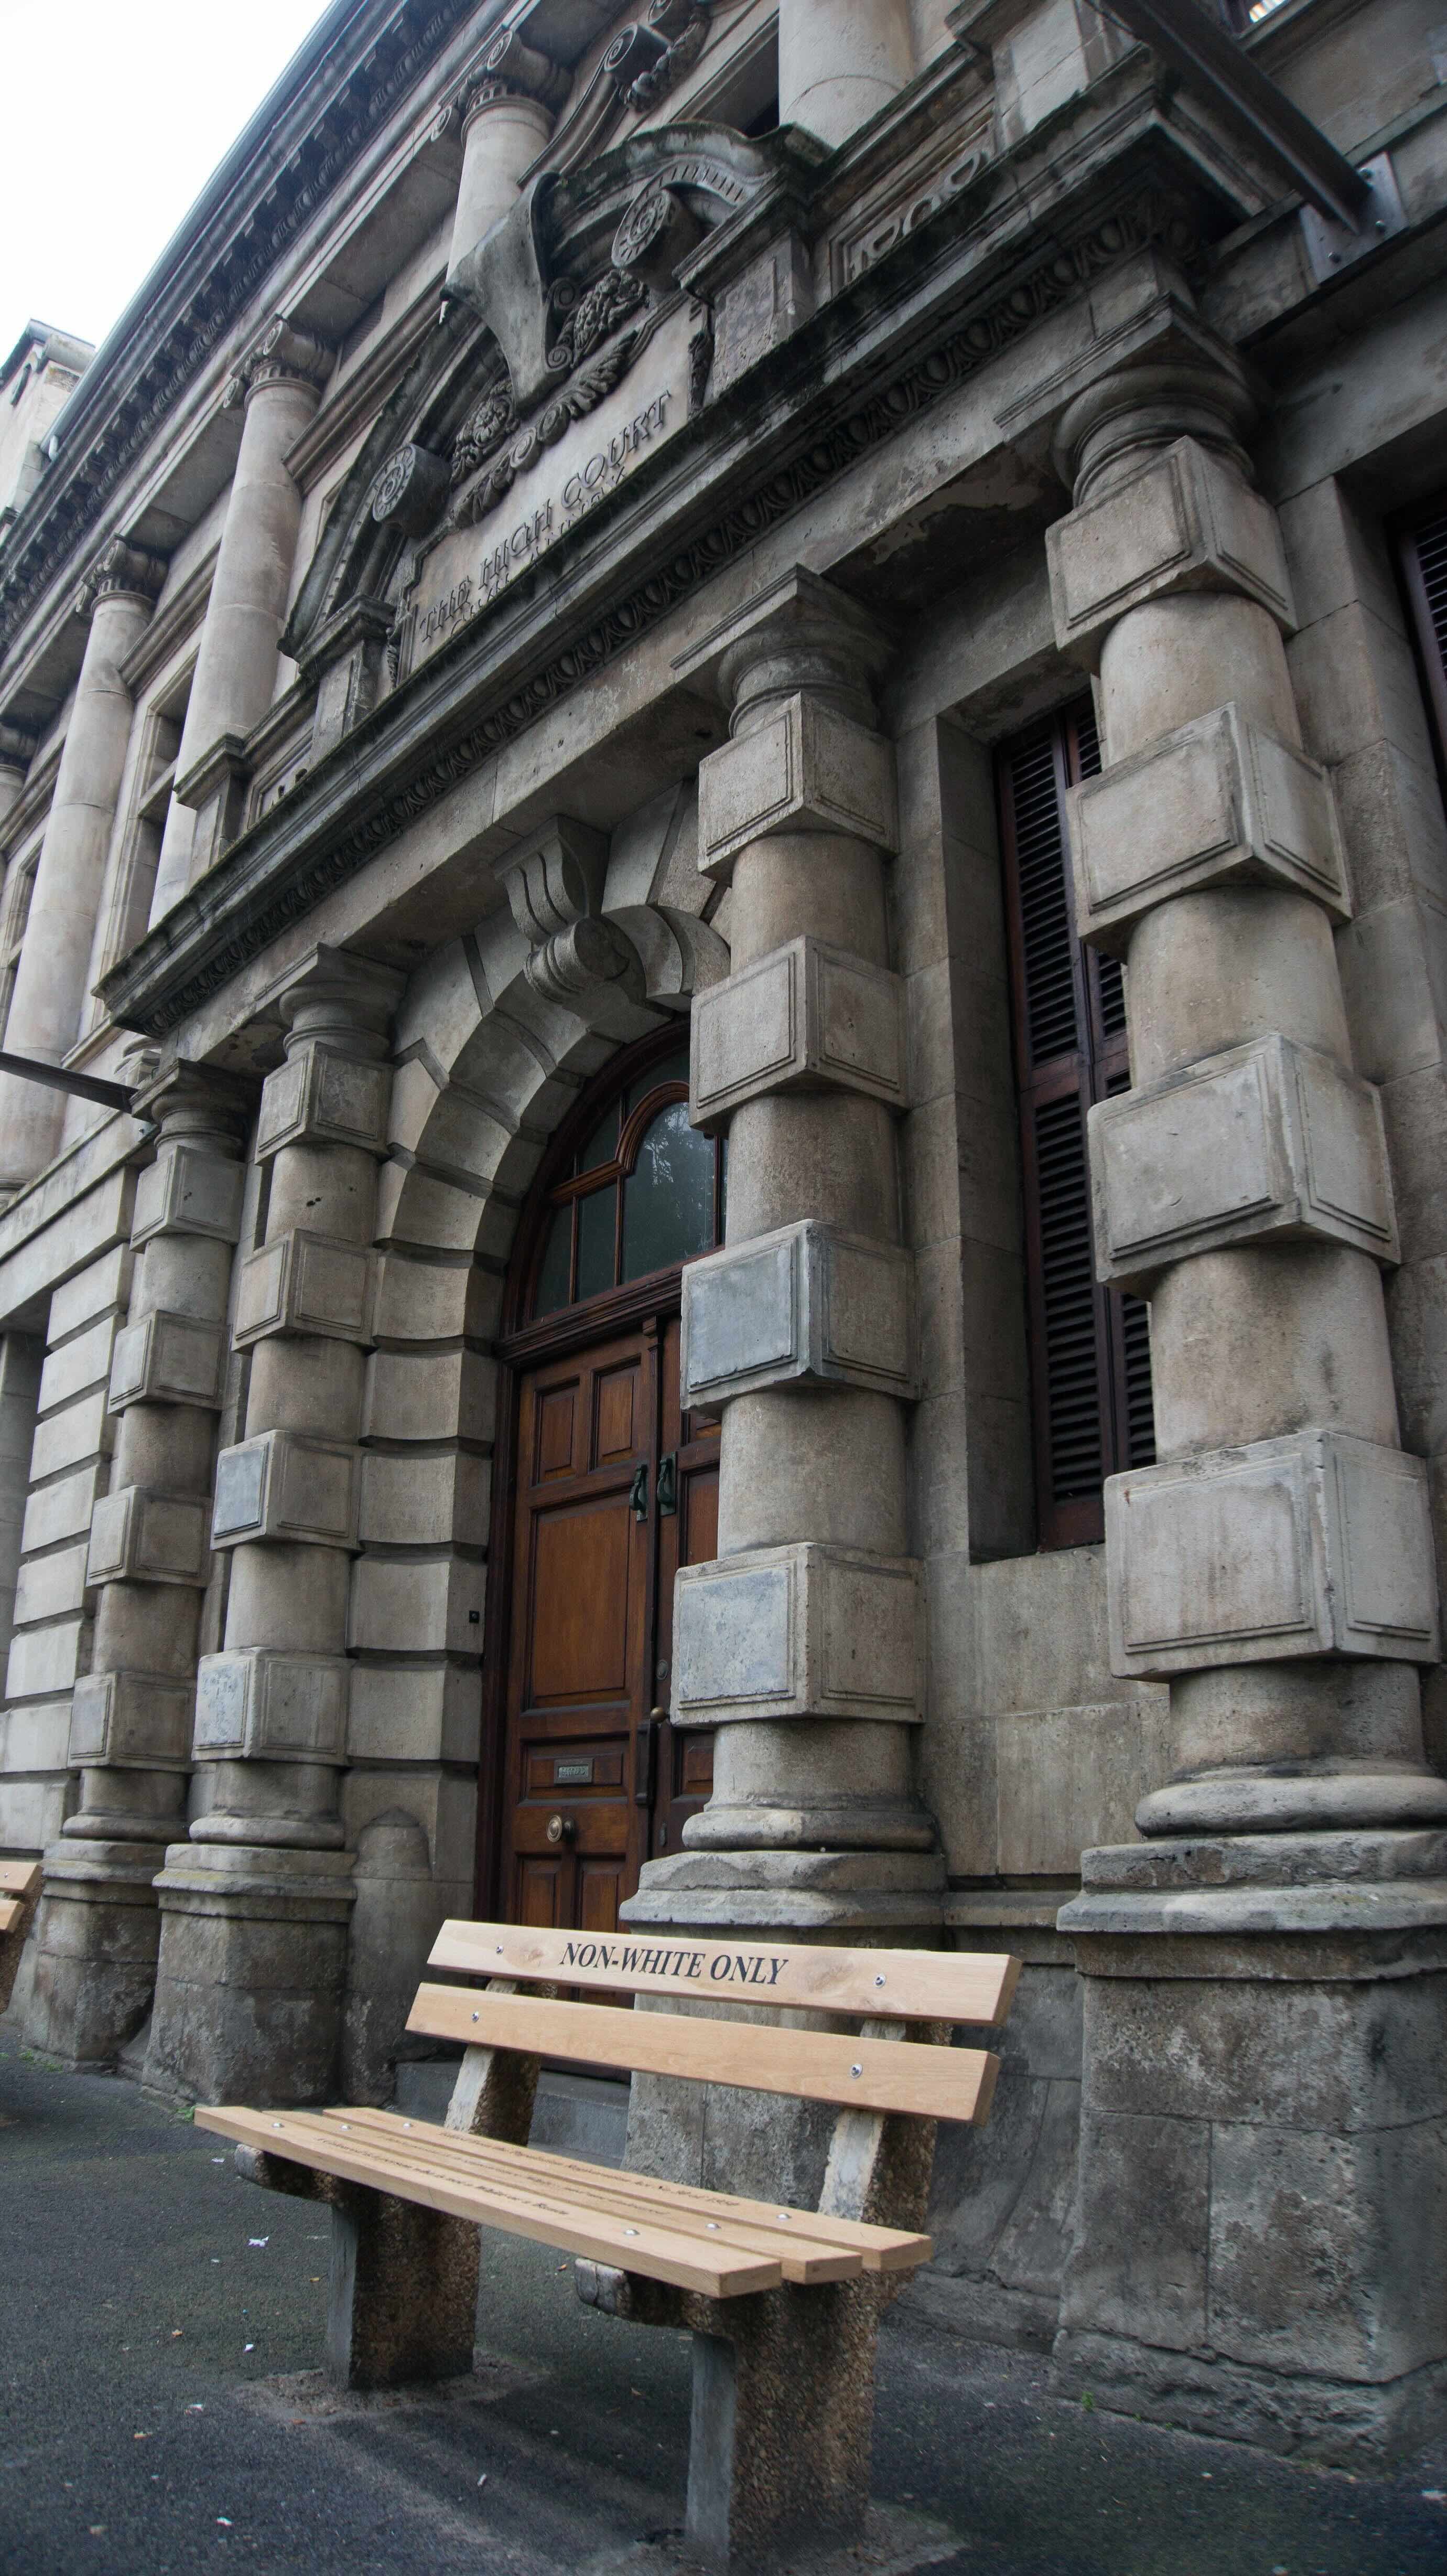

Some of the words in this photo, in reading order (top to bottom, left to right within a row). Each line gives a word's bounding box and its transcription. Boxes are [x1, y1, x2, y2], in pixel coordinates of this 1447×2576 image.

[419, 575, 471, 642] THE
[478, 498, 552, 591] HIGH
[561, 390, 671, 509] COURT
[558, 1942, 706, 1978] NON-WHITE
[709, 1954, 789, 1985] ONLY
